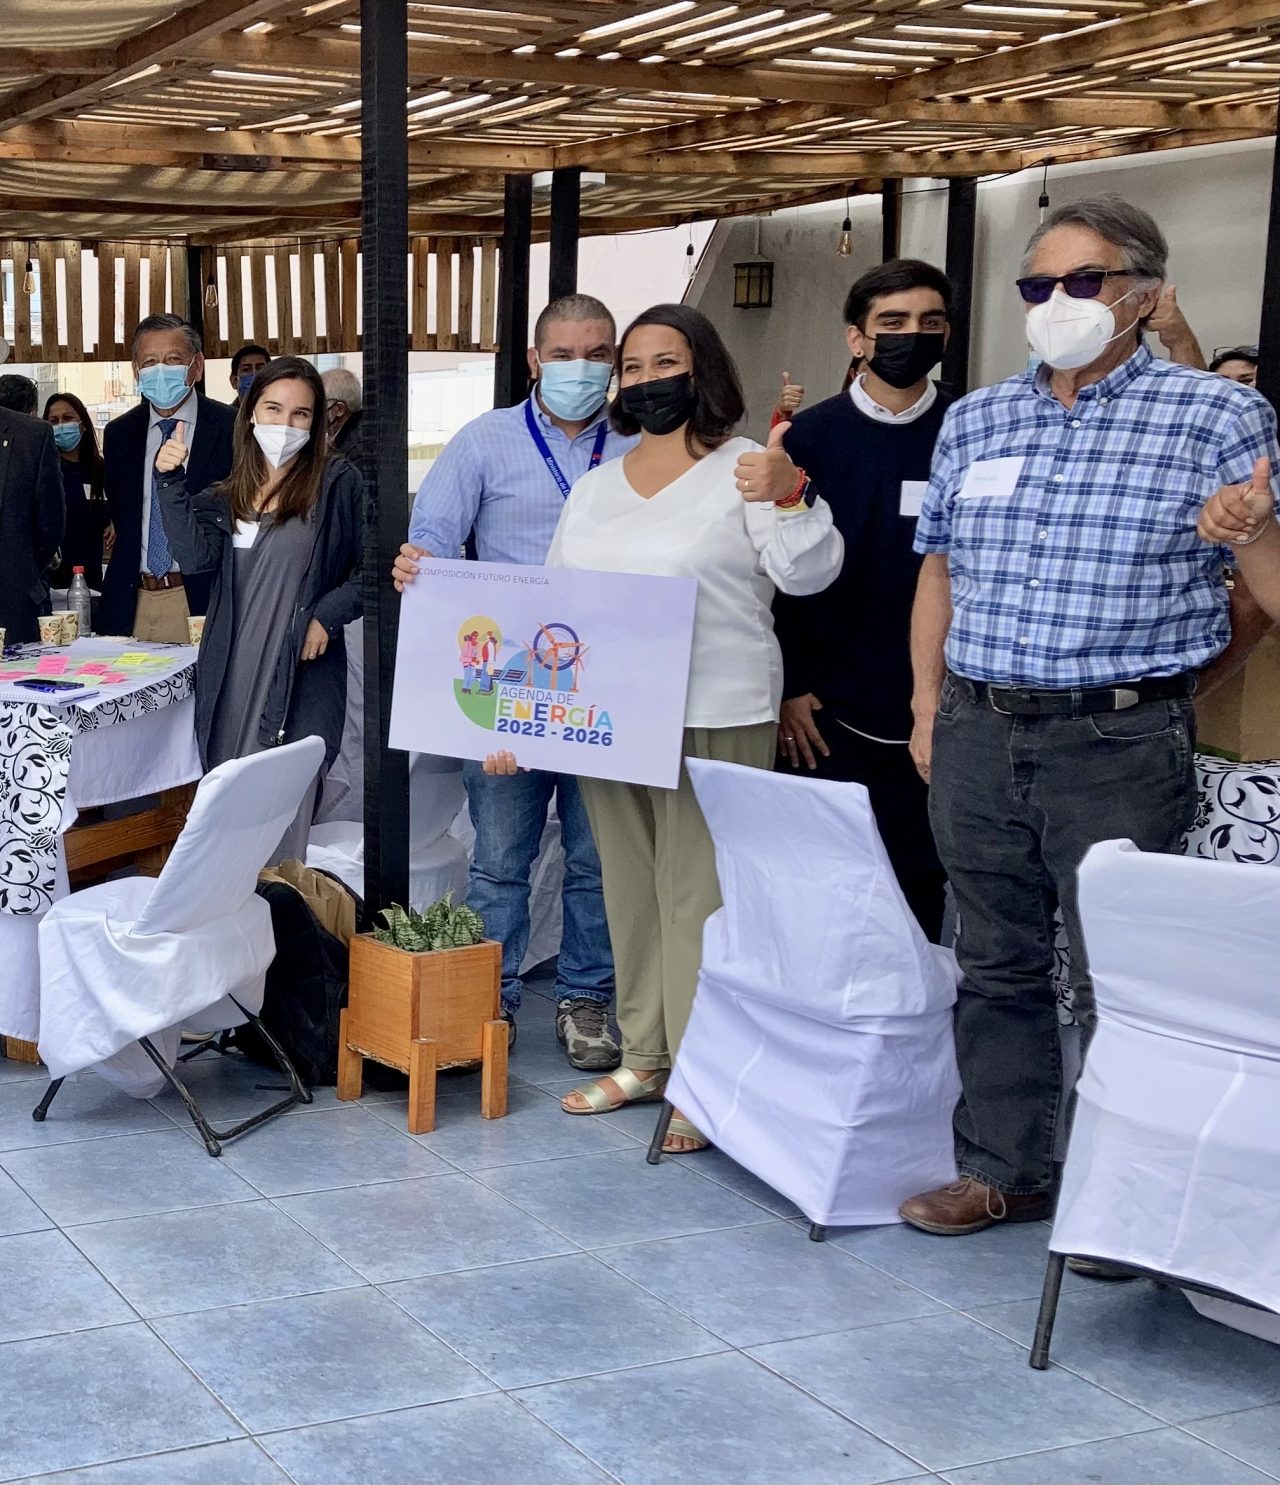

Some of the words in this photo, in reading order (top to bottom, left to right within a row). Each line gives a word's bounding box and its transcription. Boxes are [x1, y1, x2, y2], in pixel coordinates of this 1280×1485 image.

[478, 573, 511, 583] FUTURO
[500, 686, 553, 702] AGENDA
[557, 693, 574, 705] DE
[498, 698, 613, 730] ENERGÍA
[497, 718, 546, 738] 2022
[562, 726, 613, 747] 2026
